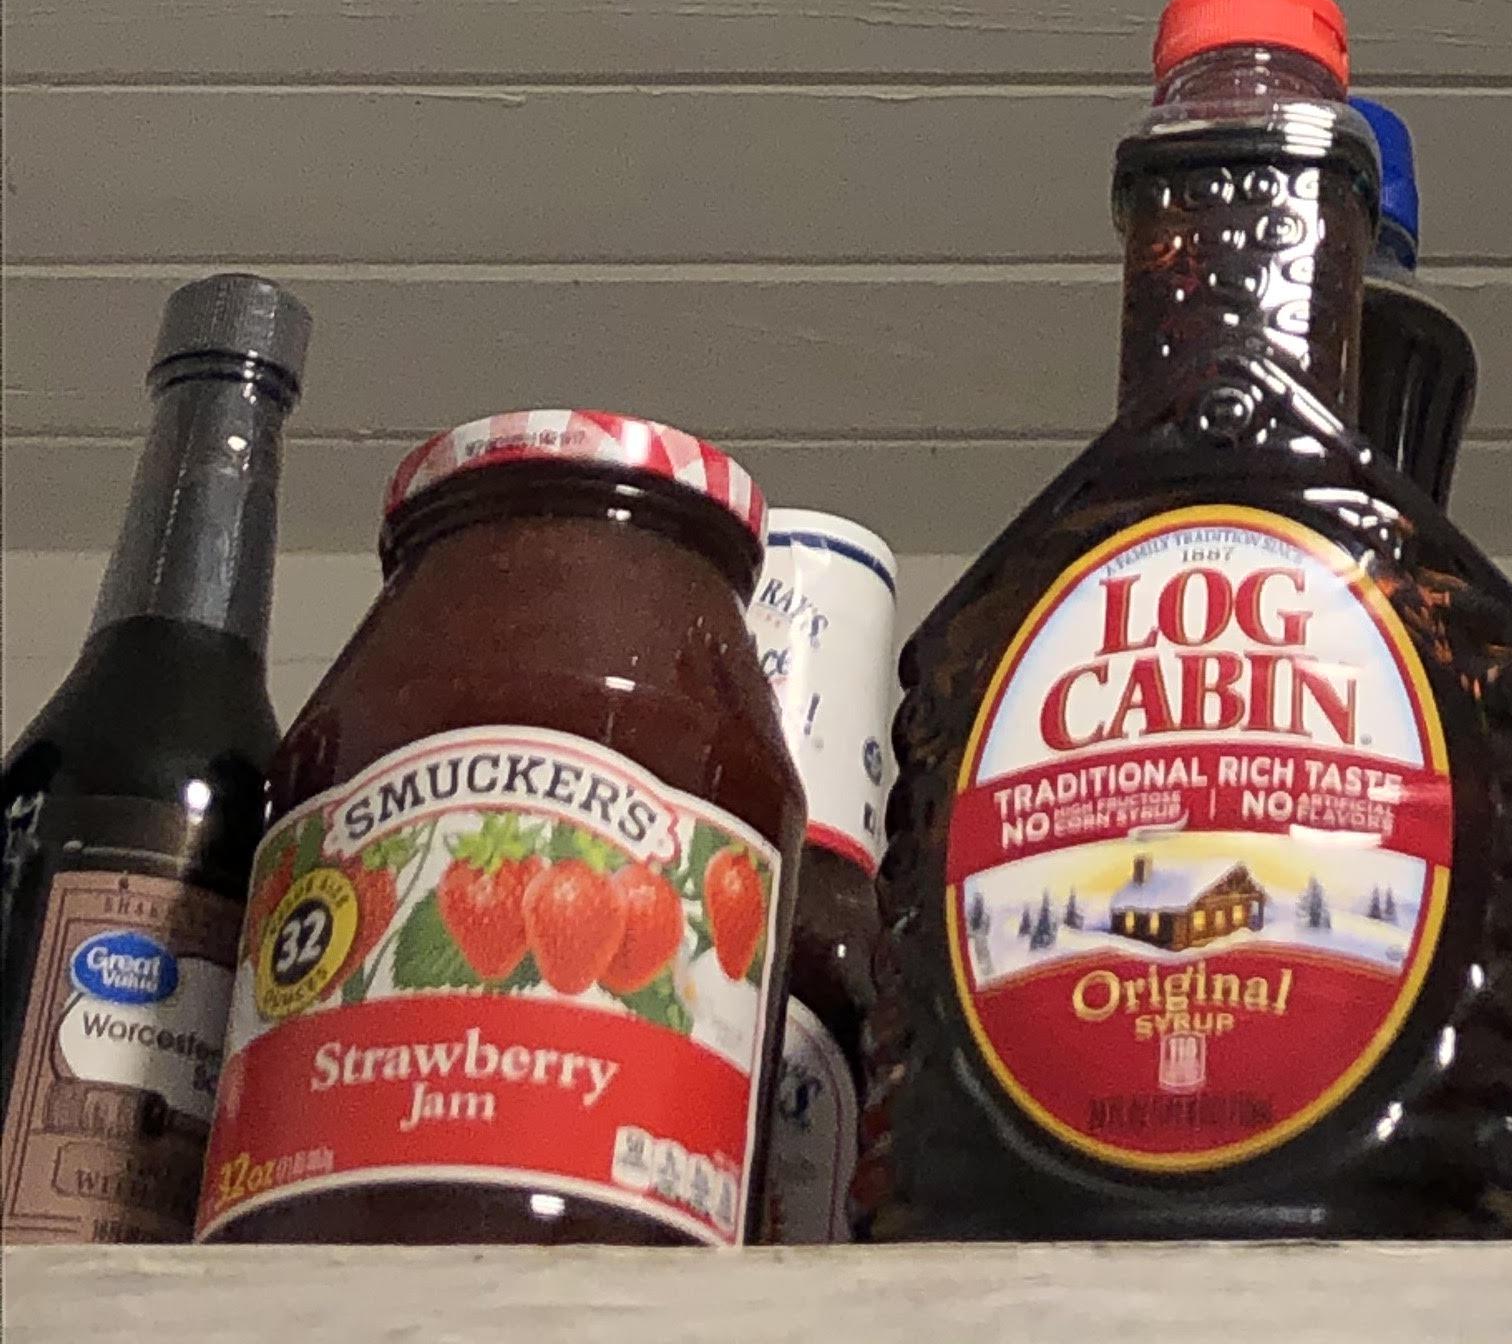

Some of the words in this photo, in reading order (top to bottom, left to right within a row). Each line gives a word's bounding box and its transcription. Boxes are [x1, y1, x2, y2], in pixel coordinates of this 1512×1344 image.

[1096, 566, 1312, 656] LOG
[1040, 650, 1357, 751] CABIN
[344, 753, 658, 843] SMUCKER'S
[994, 757, 1208, 820] TRADITIONAL
[1217, 755, 1294, 789] RICH
[1304, 758, 1403, 801] TASTE
[1242, 789, 1294, 822] NO
[1002, 811, 1050, 850] NO
[87, 946, 161, 977] Great
[276, 909, 326, 973] 32
[1072, 958, 1293, 1022] Original
[1135, 1013, 1236, 1041] SYRUP
[311, 1028, 620, 1105] Strawberry
[400, 1083, 496, 1130] Jam
